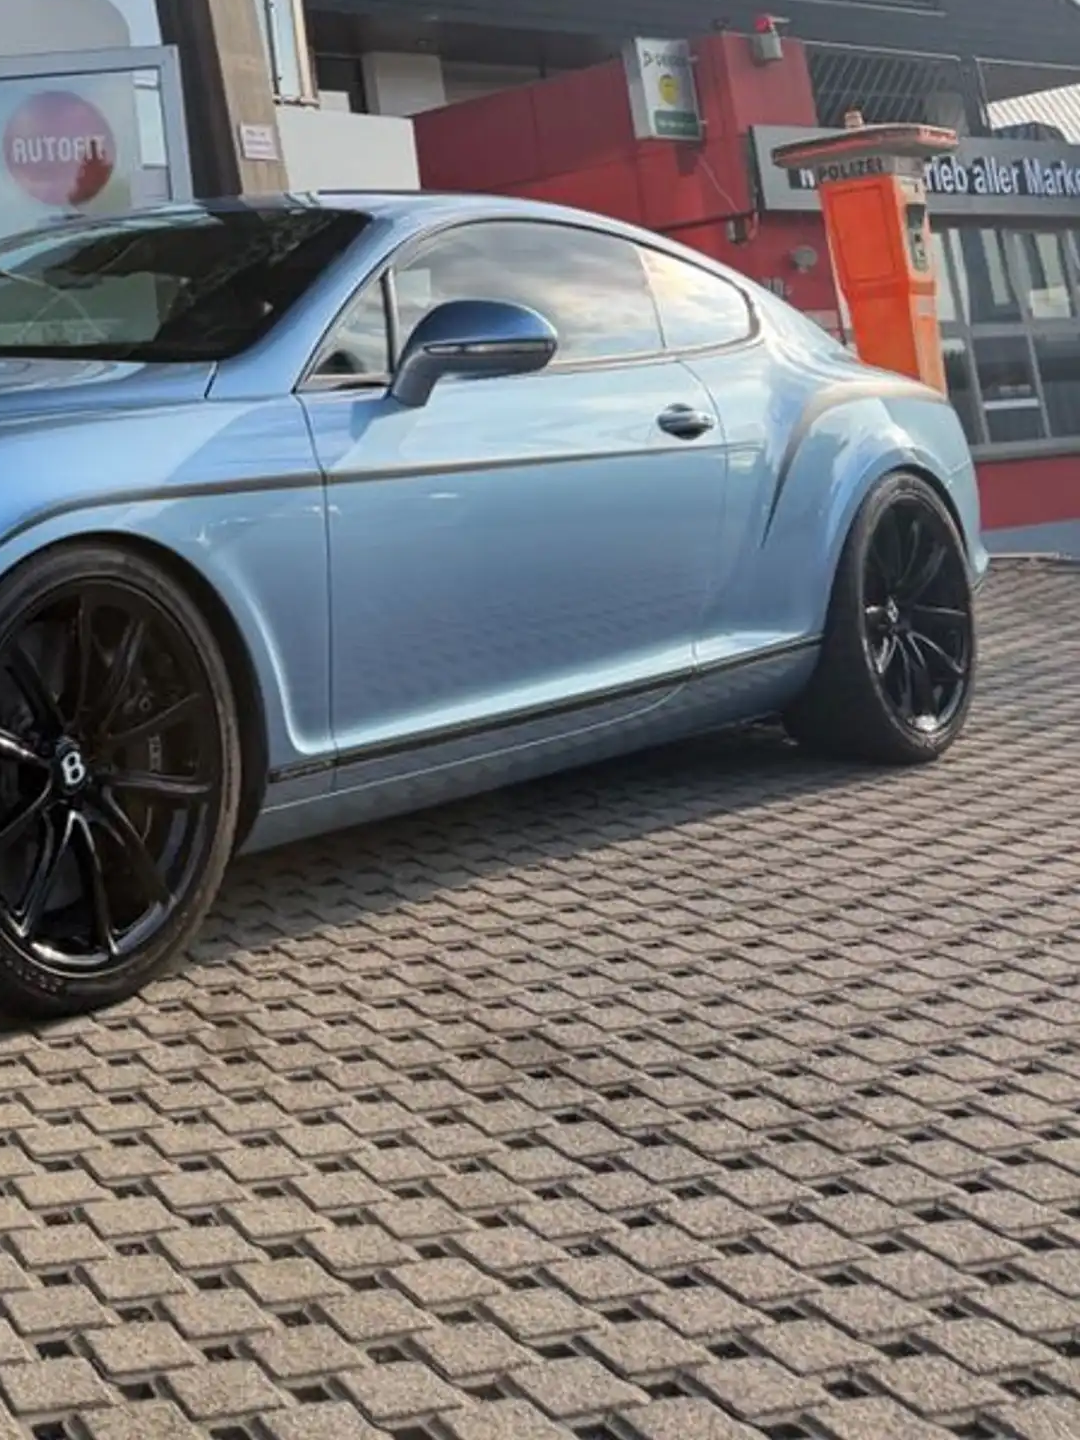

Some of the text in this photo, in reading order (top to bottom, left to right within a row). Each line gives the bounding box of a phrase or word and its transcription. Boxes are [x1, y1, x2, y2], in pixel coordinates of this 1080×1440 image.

[12, 135, 105, 164] AUTOFIT
[817, 157, 883, 184] POLIZEI
[923, 156, 969, 192] rieb
[972, 157, 1021, 194] aller
